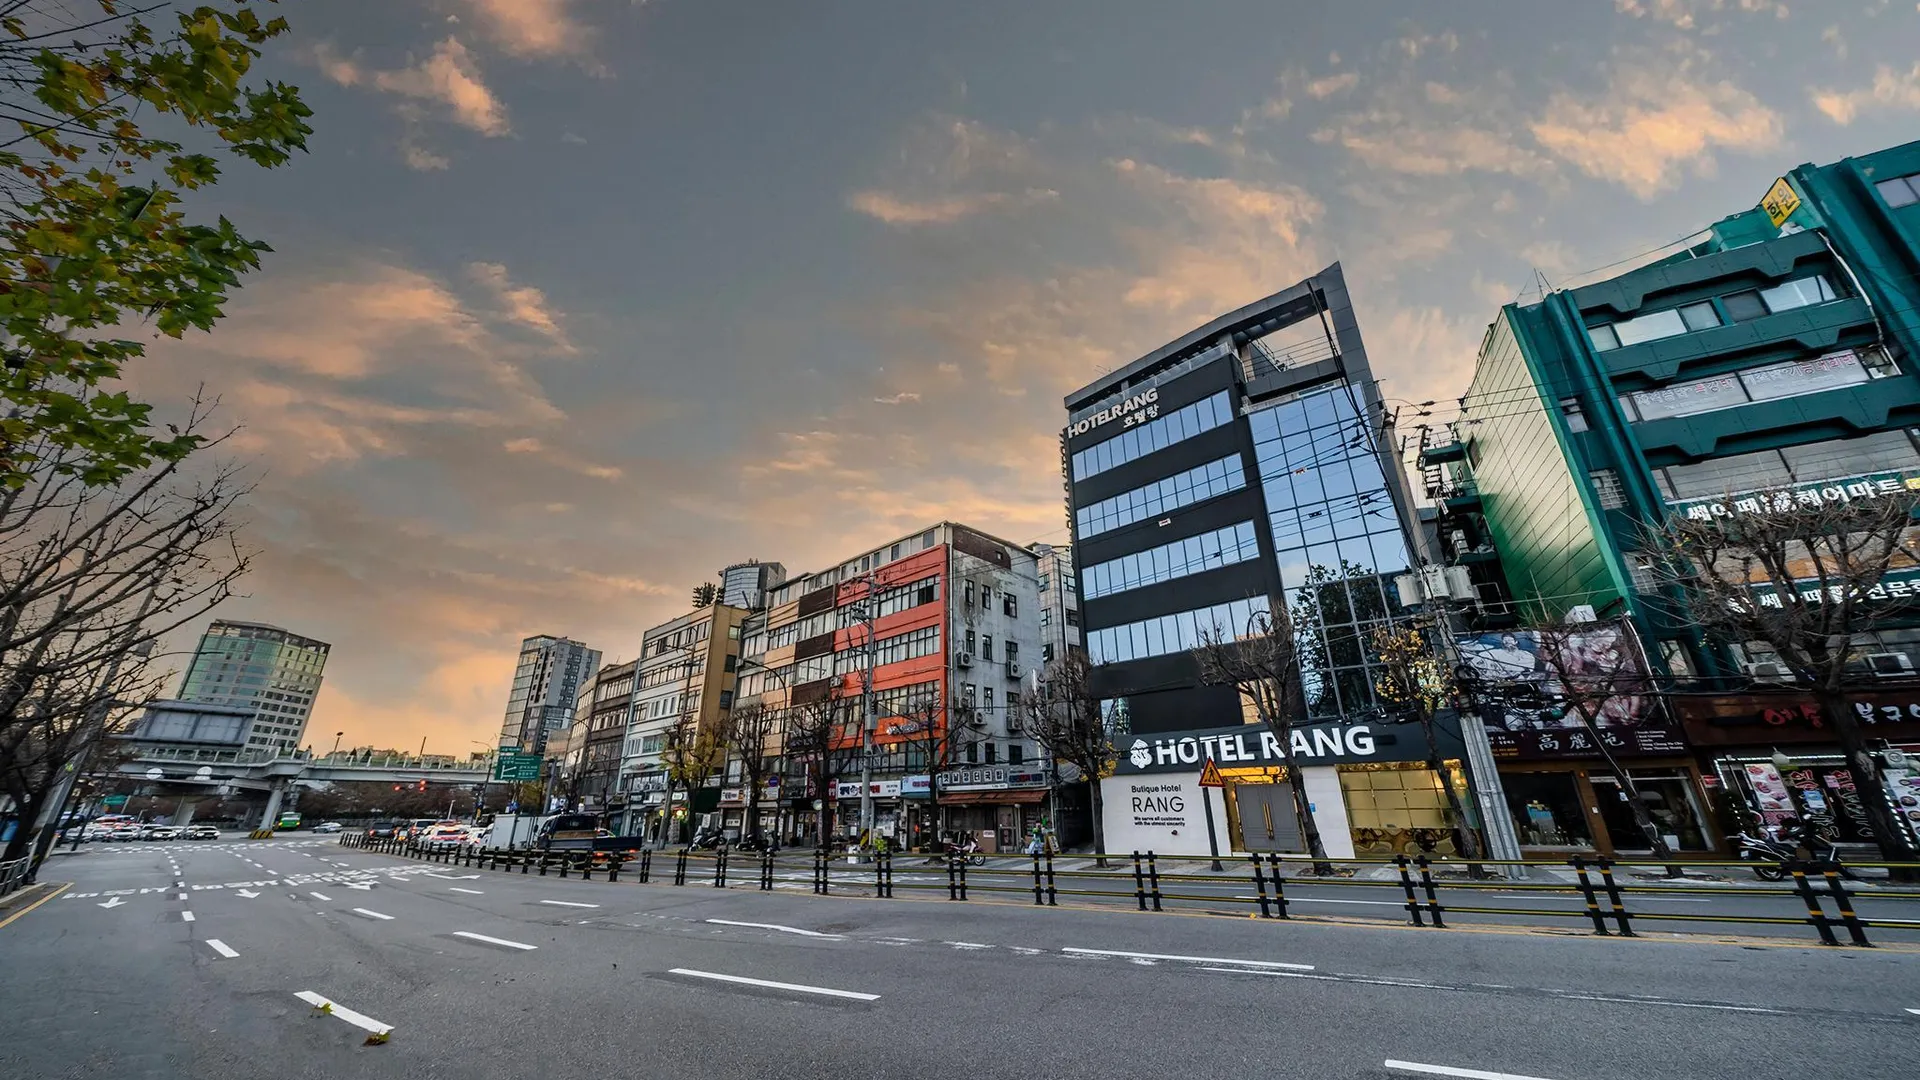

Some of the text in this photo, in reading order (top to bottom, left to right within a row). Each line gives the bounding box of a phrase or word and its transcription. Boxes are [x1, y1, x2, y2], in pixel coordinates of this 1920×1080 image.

[1067, 387, 1158, 438] HOTELRANG
[1123, 404, 1159, 428] 호텔랑
[1156, 725, 1376, 765] HOTEL RANG
[1160, 784, 1182, 792] Hotel
[1132, 796, 1184, 812] RANG
